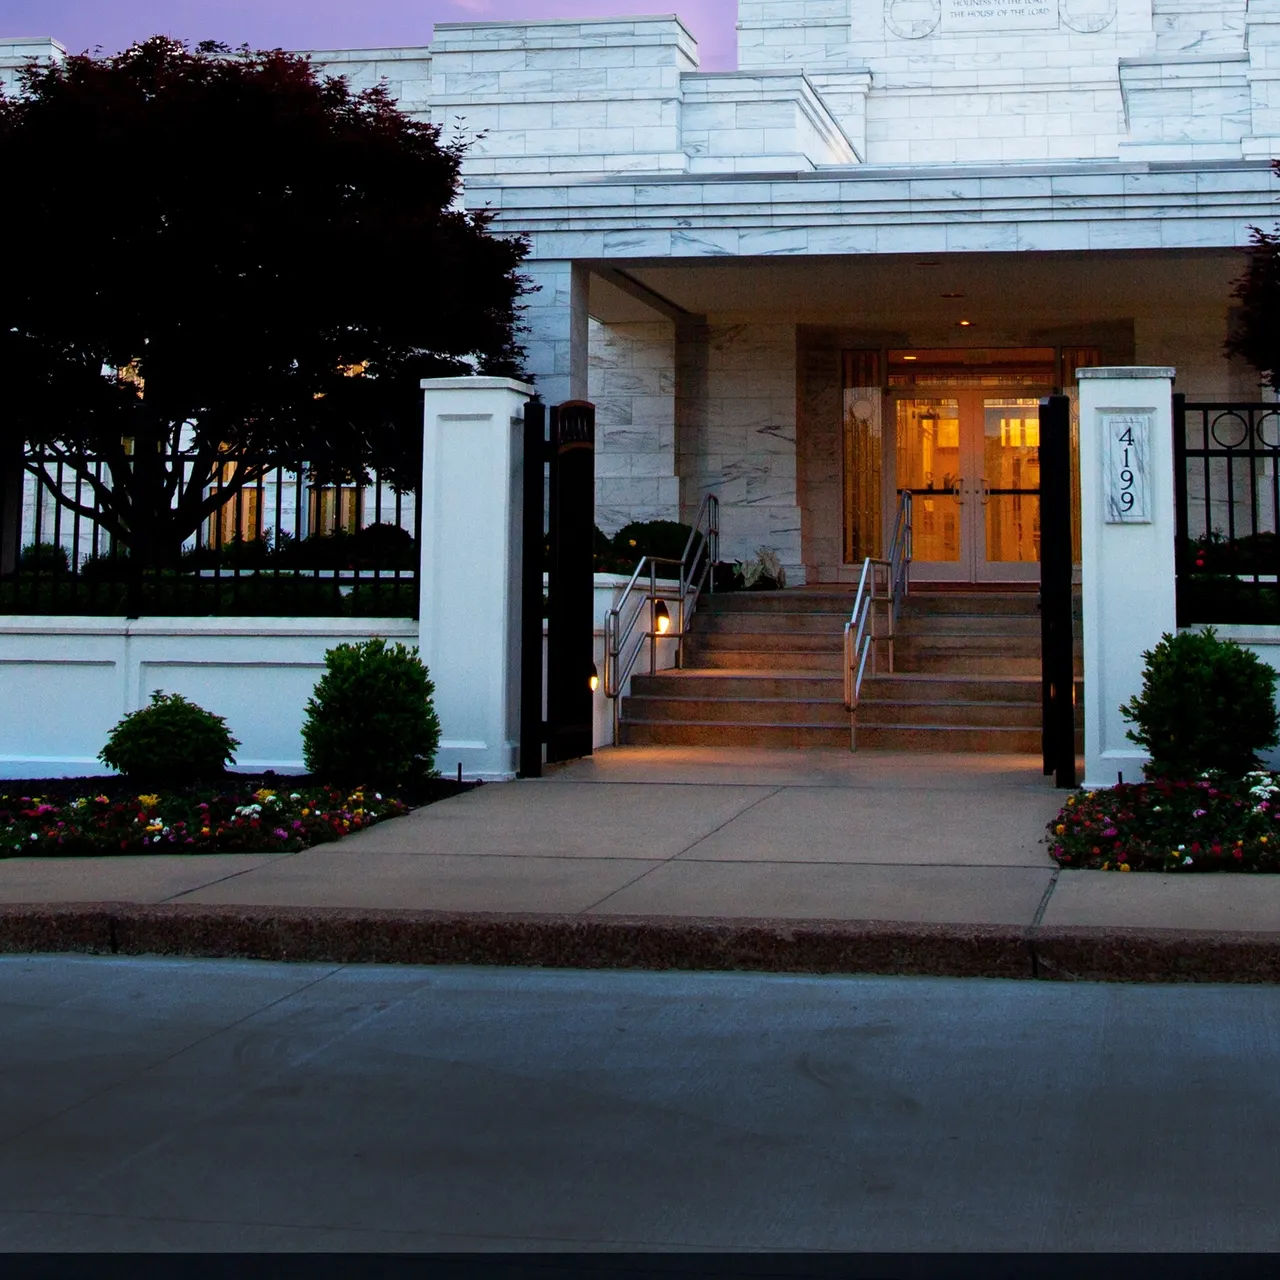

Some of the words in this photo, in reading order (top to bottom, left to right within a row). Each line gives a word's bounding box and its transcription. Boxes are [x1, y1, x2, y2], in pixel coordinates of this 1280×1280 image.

[953, 0, 992, 7] HOLINESS
[968, 10, 995, 18] HOUSE
[1028, 8, 1050, 16] LORD
[1118, 426, 1135, 513] 4199
